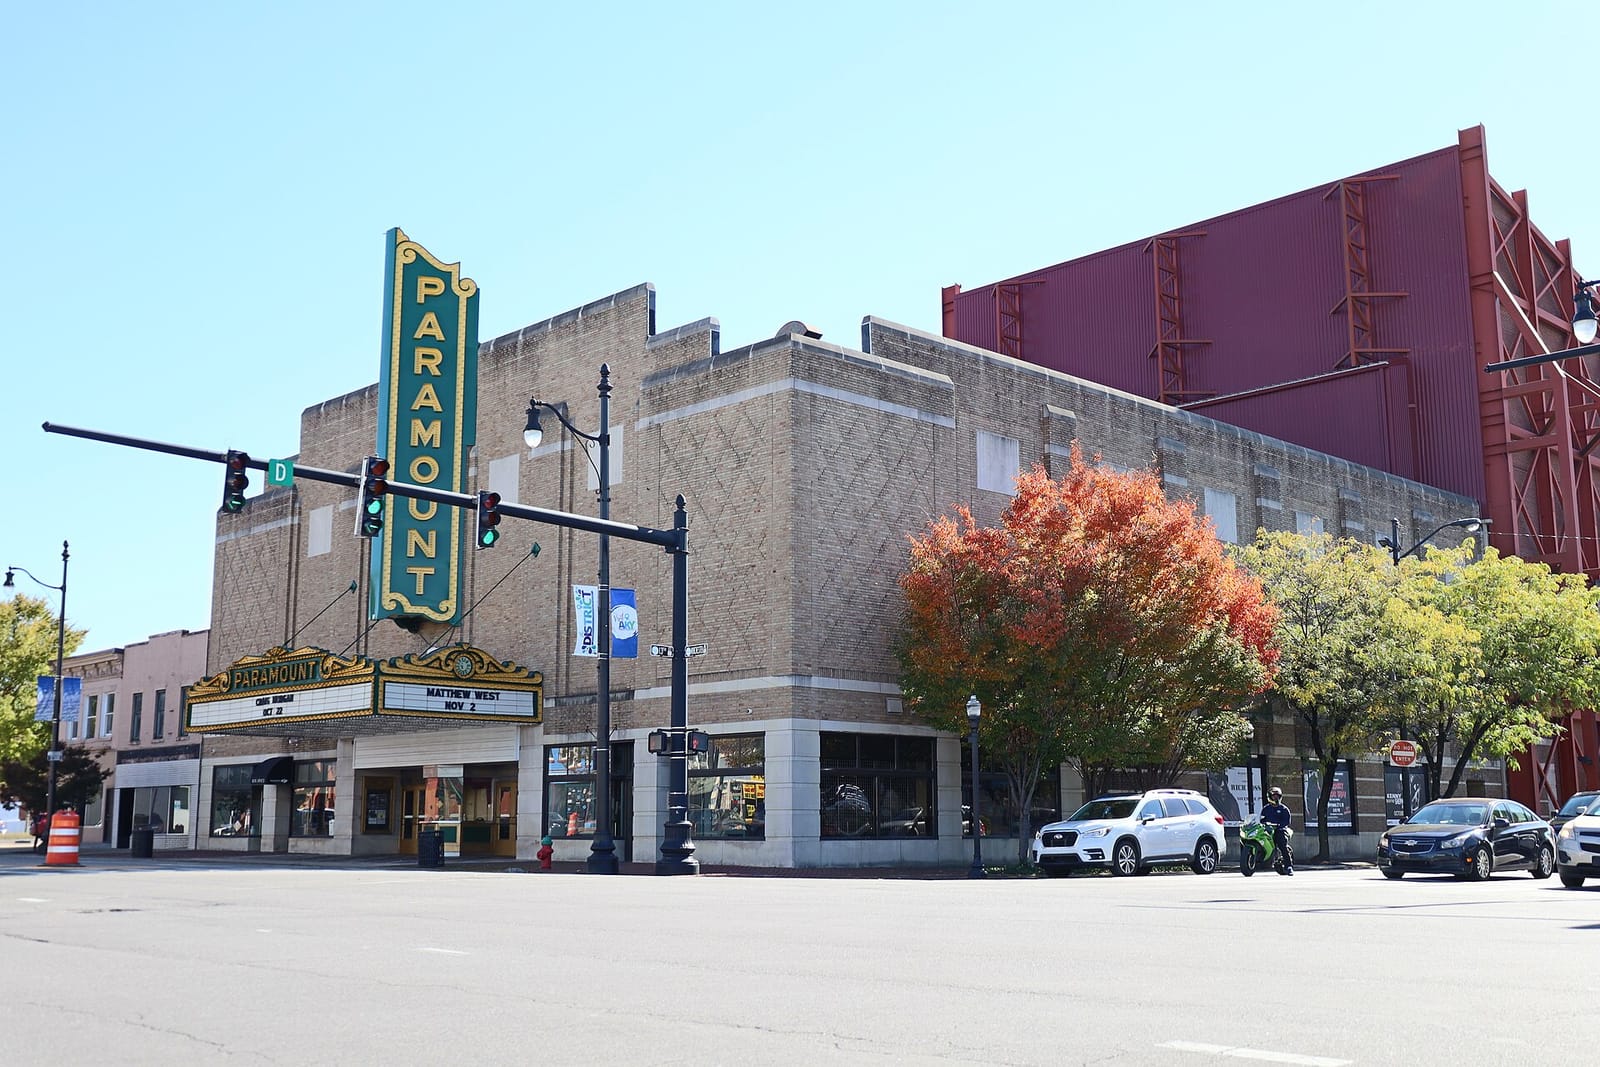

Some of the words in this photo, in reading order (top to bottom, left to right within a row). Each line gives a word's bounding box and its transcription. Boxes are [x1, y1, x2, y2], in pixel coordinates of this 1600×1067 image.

[405, 275, 447, 595] PARAMOUNT
[275, 463, 286, 482] D
[582, 590, 592, 645] DISTRICT
[234, 661, 317, 689] PARAMOUNT
[426, 687, 471, 699] MATTHEW
[475, 690, 500, 701] WEST
[263, 708, 273, 716] OCT
[445, 700, 465, 711] NOV
[470, 702, 476, 712] 2
